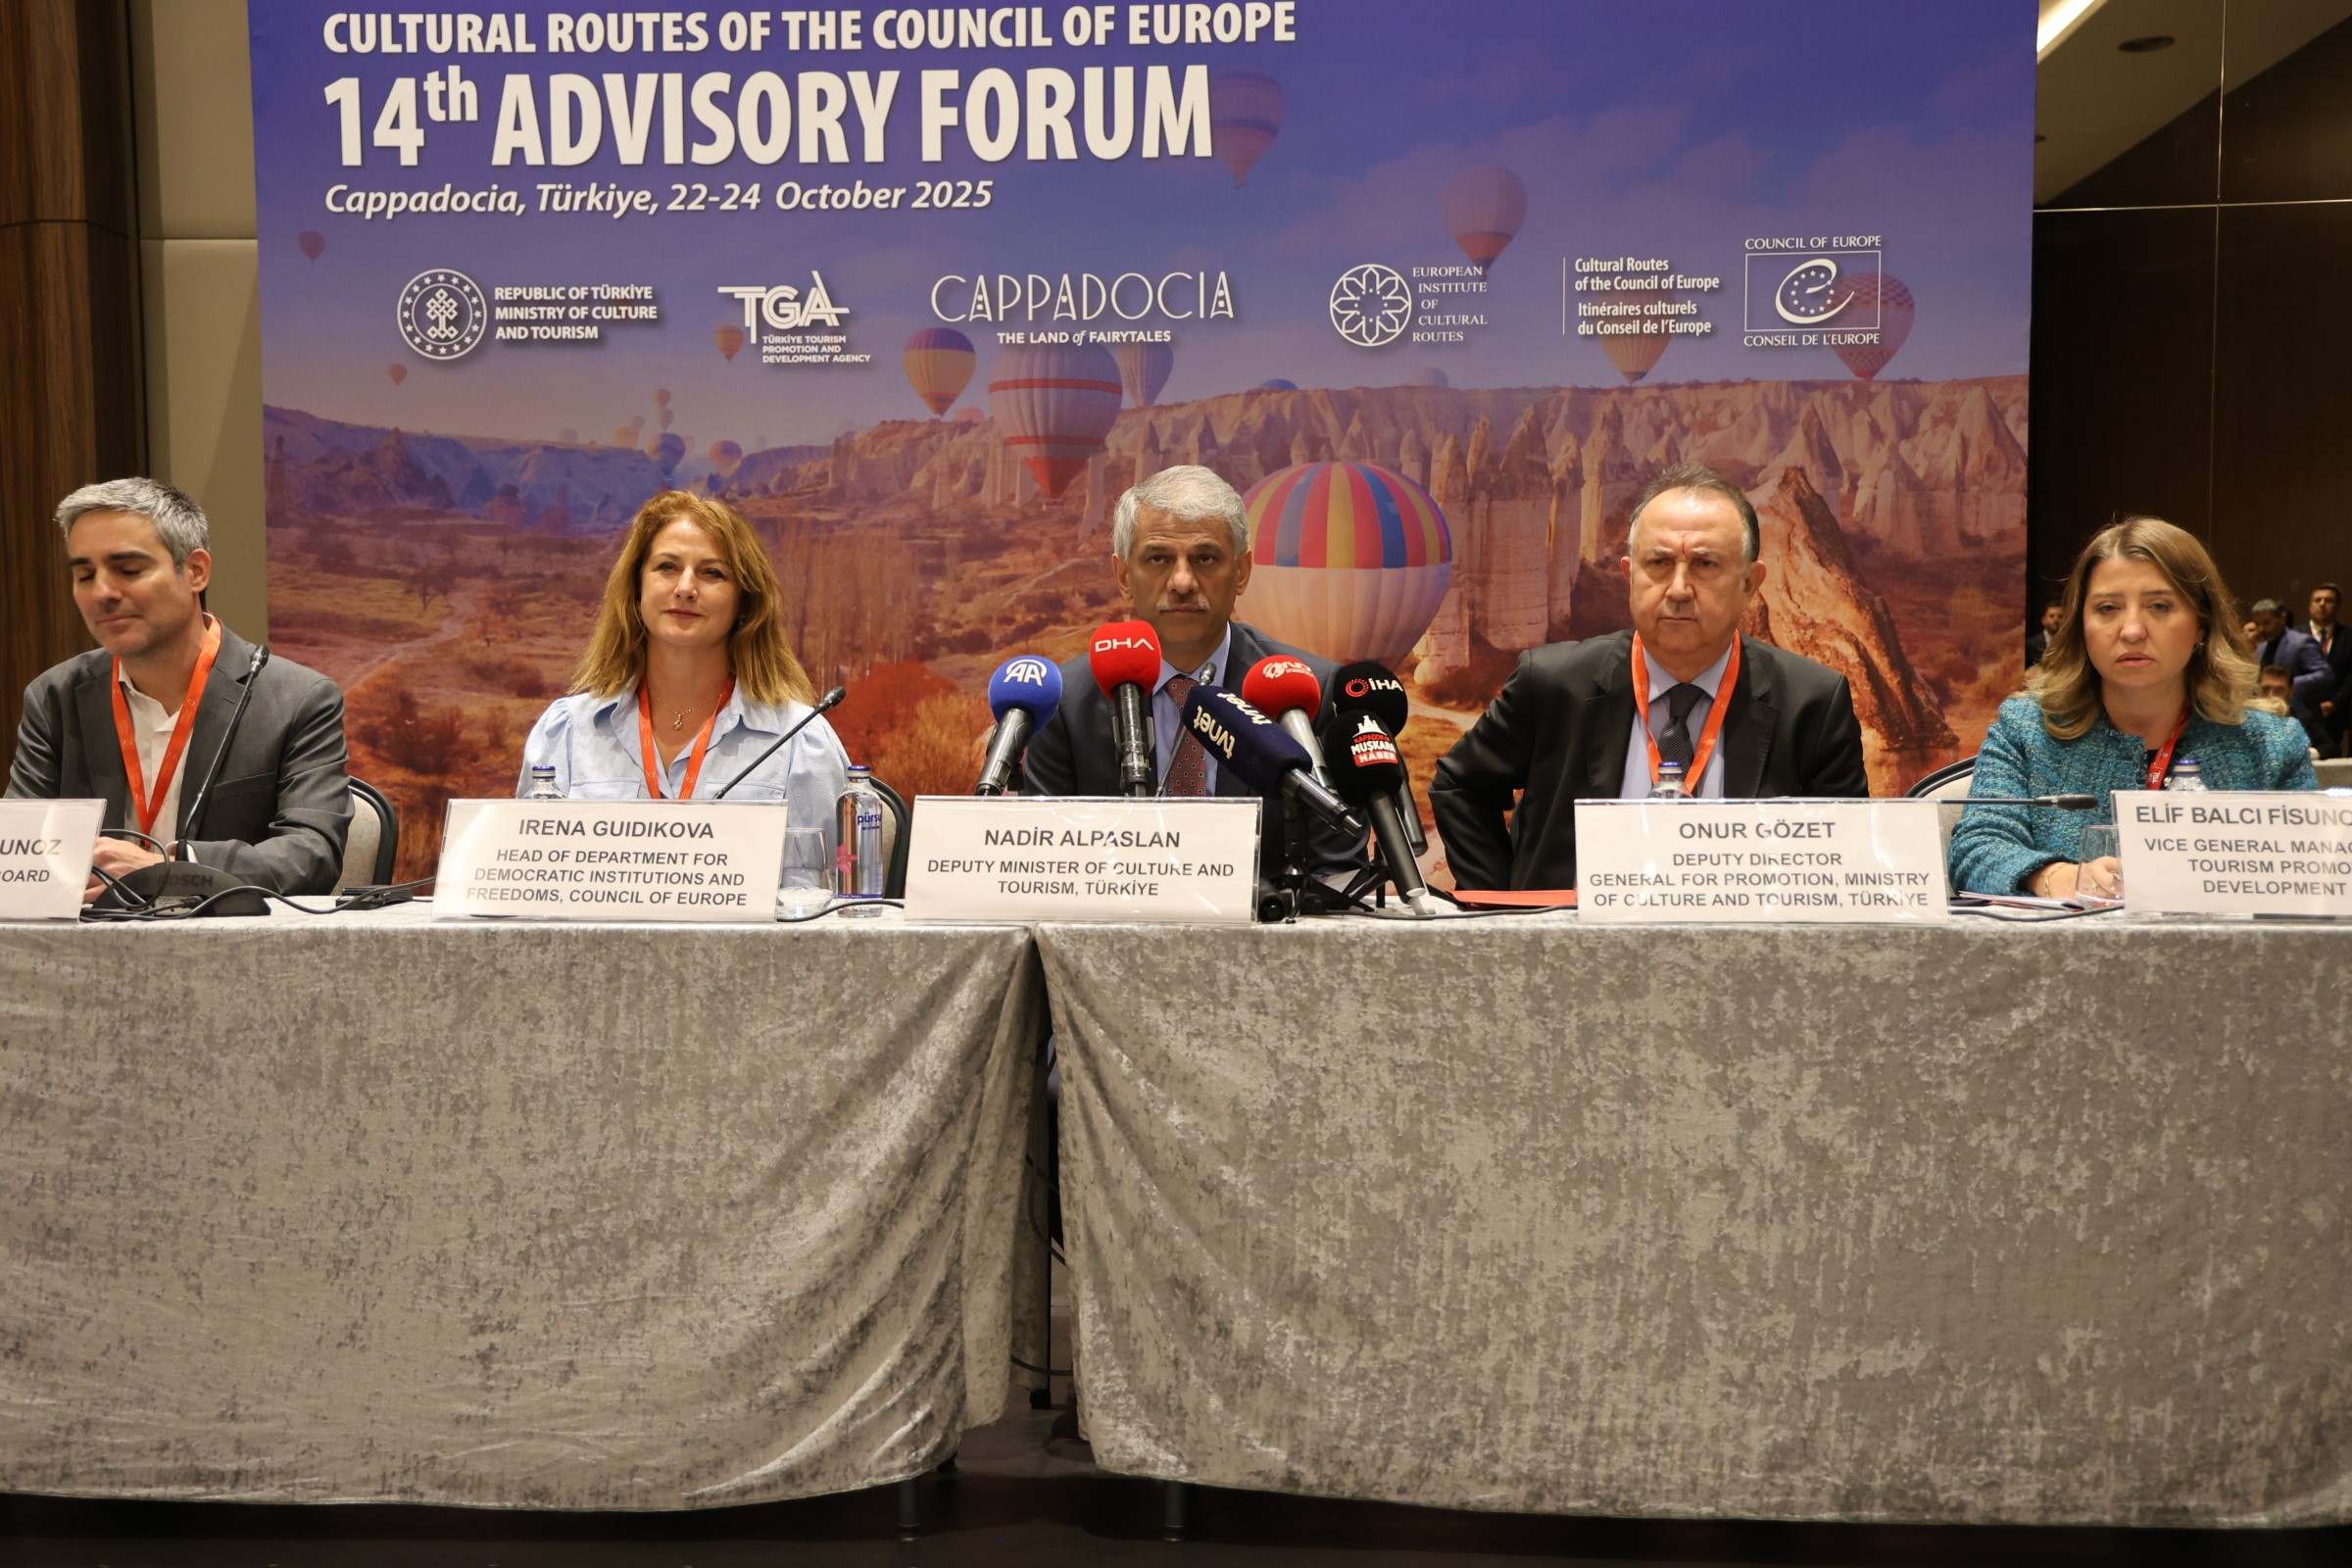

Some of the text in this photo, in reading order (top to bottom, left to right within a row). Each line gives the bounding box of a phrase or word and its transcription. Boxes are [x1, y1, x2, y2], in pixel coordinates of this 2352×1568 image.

[323, 2, 1295, 53] CULTURAL ROUTES OF THE COUNCIL OF EUROPE
[324, 65, 1211, 166] 14th ADVISORY FORUM
[326, 180, 993, 219] Cappadocia, Türkiye, 22-24 October 2025
[1745, 236, 1881, 249] COUNCIL OF EUROPE
[1413, 267, 1482, 276] EUROPEAN
[1575, 258, 1668, 271] Cultural Routes
[1419, 282, 1487, 293] INSTITUTE
[1575, 274, 1719, 291] of the Council of Europe
[495, 284, 652, 300] REPUBLIC OF TÜRKİYE
[931, 271, 1233, 321] CAPPADOCIA
[495, 306, 657, 319] MINISTRY OF CULTURE
[717, 270, 850, 344] TGA
[1421, 300, 1438, 309] OF
[1579, 300, 1696, 316] Itinéraires culturels
[1419, 315, 1488, 325] CULTURAL
[1578, 320, 1593, 334] du
[1596, 319, 1640, 334] Conseil
[1643, 319, 1658, 333] de
[496, 326, 598, 339] AND TOURISM
[762, 334, 802, 344] TÜRKİYE
[998, 330, 1170, 346] THE LAND of FAIRYTALES
[1413, 332, 1463, 342] ROUTES
[1744, 335, 1797, 346] CONSEIL
[1802, 335, 1818, 345] DE
[1095, 637, 1154, 653] DHA
[1004, 663, 1043, 686] AA
[1368, 677, 1404, 692] İHA
[1216, 692, 1273, 725] tvnet
[1193, 705, 1236, 760] tvnet
[1358, 751, 1396, 763] HABER
[2135, 803, 2183, 823] ELİF
[2191, 807, 2262, 825] BALCI
[518, 819, 714, 839] IRENA GUIDIKOVA
[1679, 818, 1836, 839] ONUR GÖZET
[984, 826, 1180, 848] NADİR ALPASLAN
[2143, 838, 2188, 852] VICE
[2193, 838, 2285, 854] GENERAL
[497, 849, 728, 866] HEAD OF DEPARTMENT FOR
[1673, 853, 1842, 866] DEPUTY DIRECTOR
[927, 859, 1234, 877] DEPUTY MINISTER OF CULTURE AND
[2187, 858, 2352, 875] TOURISM PROMO
[0, 869, 50, 883] OARD
[474, 868, 745, 886] DEMOCRATIC INSTITUTIONS AND
[1590, 872, 1930, 888] GENERAL FOR PROMOTION, MINISTRY
[998, 879, 1158, 896] TOURISM, TÜRKİYE
[2203, 879, 2347, 896] DEVELOPMENT
[466, 888, 748, 906] FREEDOMS, COUNCIL OF EUROPE
[1593, 890, 1929, 907] OF CULTURE AND TOURISM, TÜRKİYE
